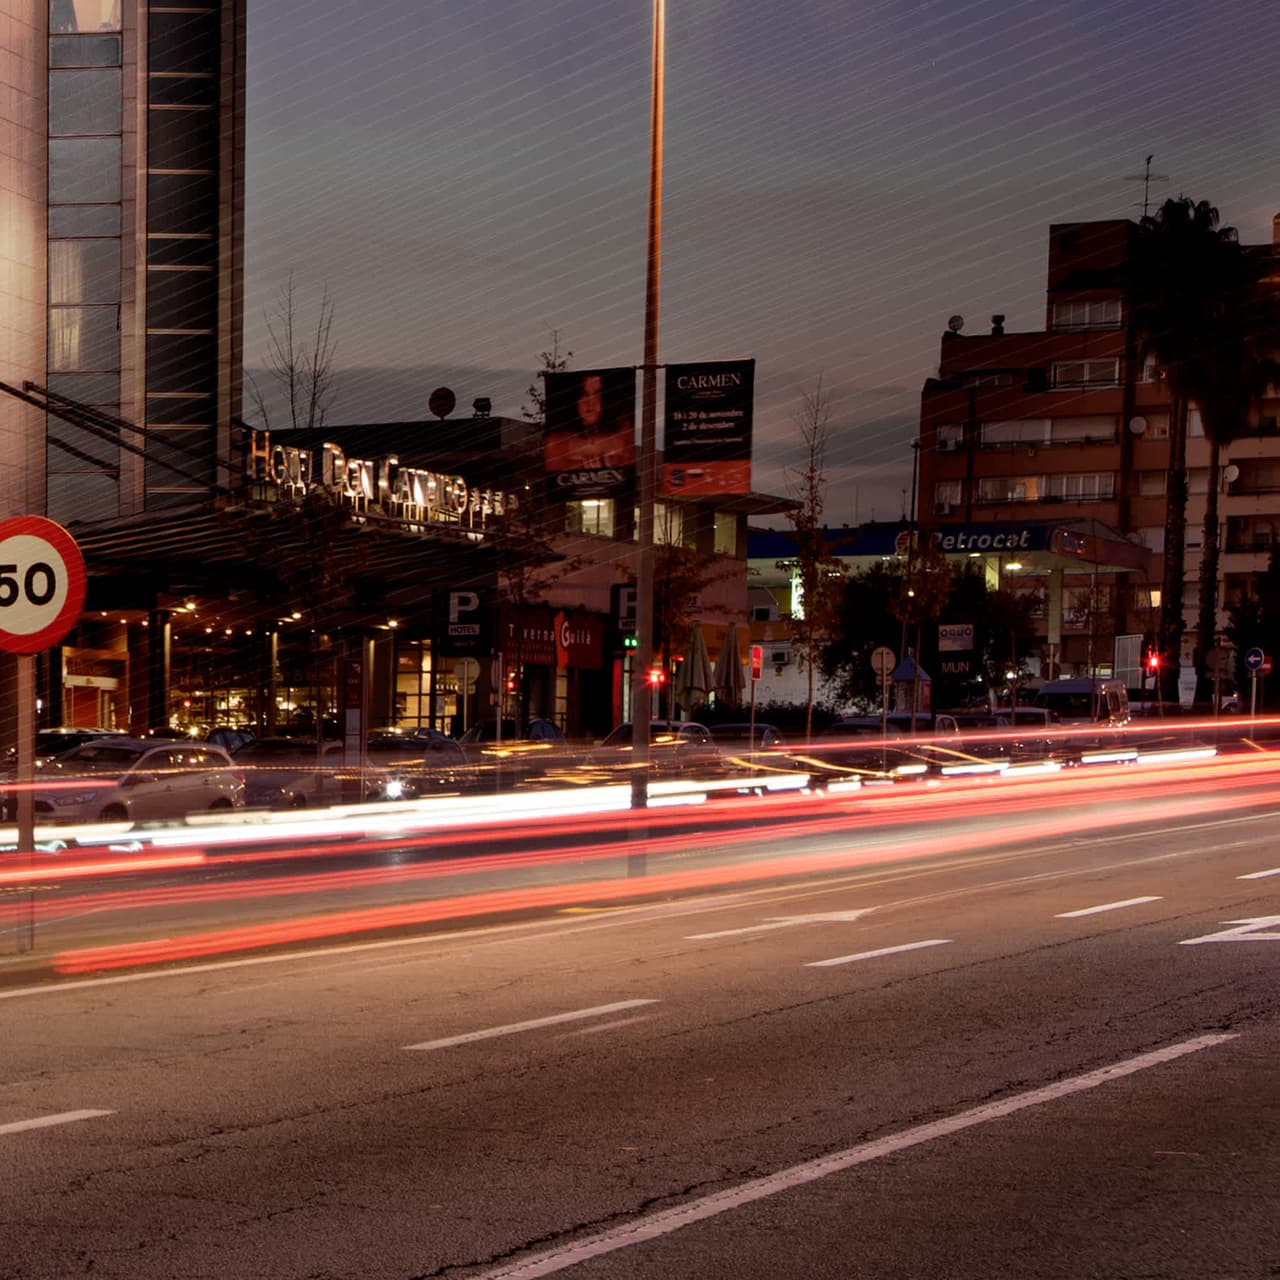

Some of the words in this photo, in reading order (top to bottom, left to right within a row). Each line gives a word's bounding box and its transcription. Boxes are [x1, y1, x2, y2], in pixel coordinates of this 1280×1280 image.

[677, 373, 741, 390] CARMEN
[556, 469, 625, 487] CARMEN
[930, 530, 1031, 550] Petrocat
[449, 591, 480, 623] P
[449, 625, 477, 635] HOTEL
[508, 623, 556, 642] Tverna
